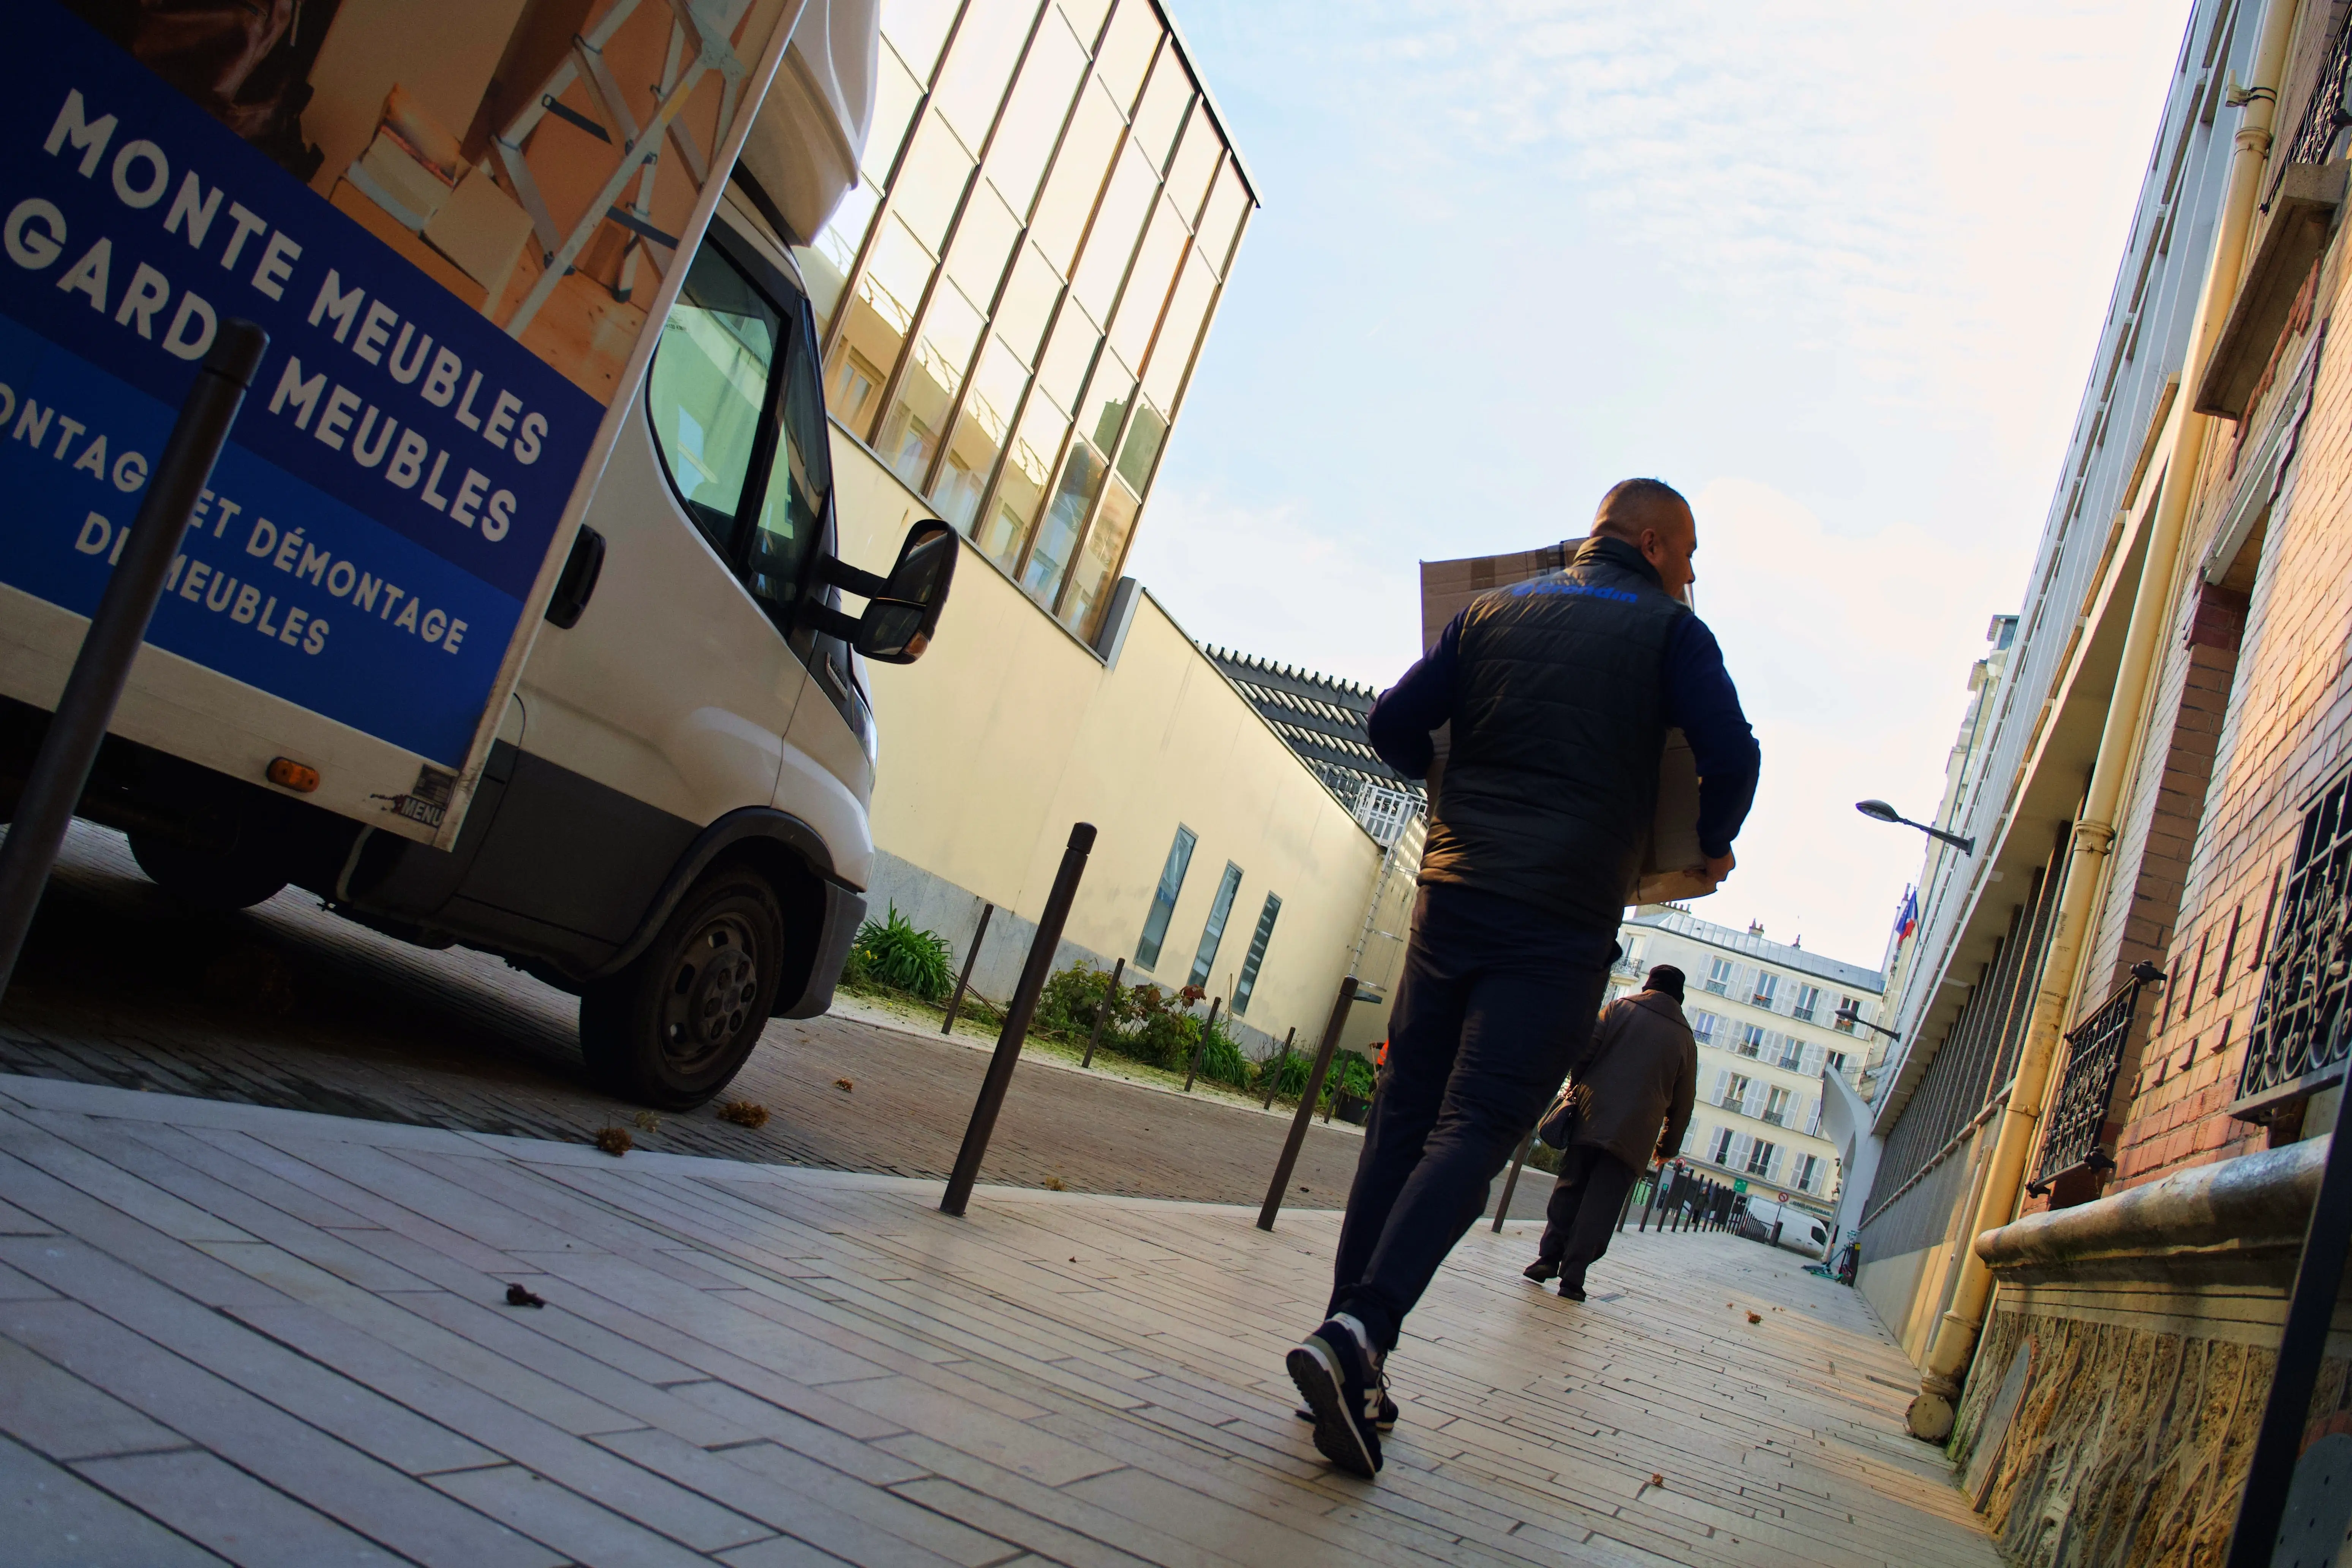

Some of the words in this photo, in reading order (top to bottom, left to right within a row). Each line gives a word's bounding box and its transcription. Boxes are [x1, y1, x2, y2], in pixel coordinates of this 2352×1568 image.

[2, 199, 217, 360] GARD
[268, 356, 515, 541] MEUBLES
[43, 88, 302, 301] MONTE
[307, 268, 547, 464] MEUBLES
[190, 488, 241, 538] ET
[246, 517, 468, 654] DÉMONTAGE
